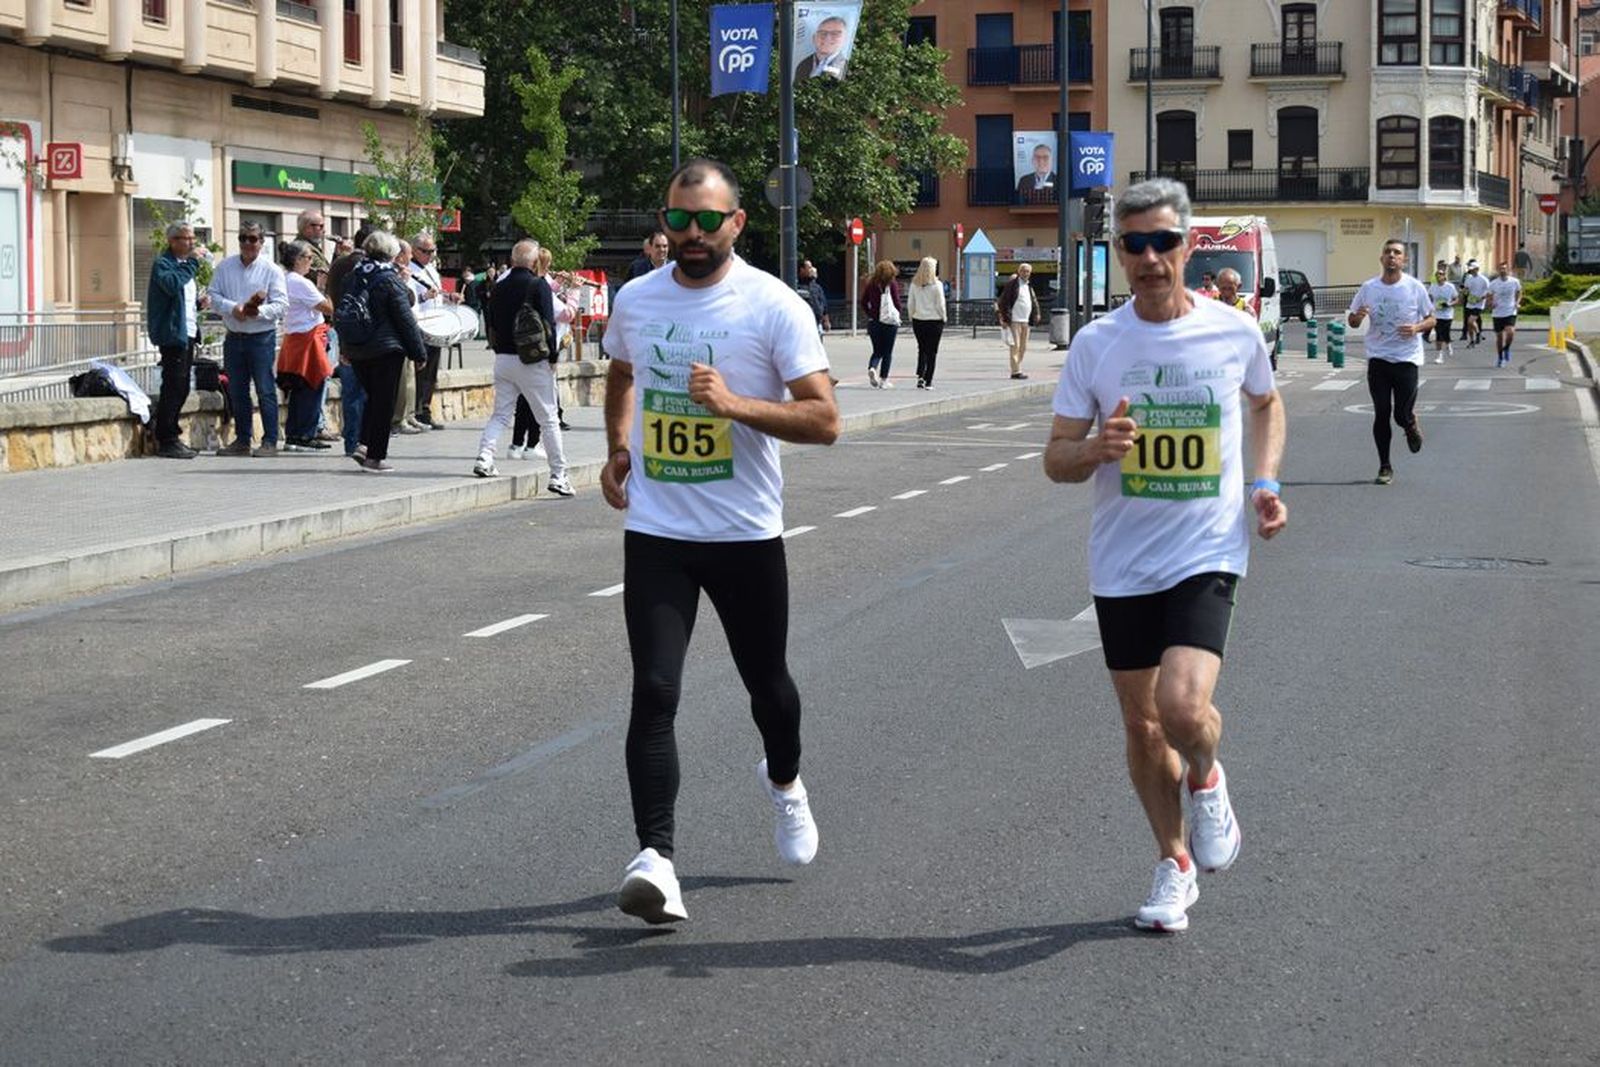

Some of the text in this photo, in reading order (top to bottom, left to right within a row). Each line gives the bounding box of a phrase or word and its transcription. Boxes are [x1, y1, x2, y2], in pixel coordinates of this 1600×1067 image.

[720, 27, 759, 41] VOTA
[1079, 146, 1105, 155] VOTA
[650, 418, 715, 457] 165
[1133, 433, 1204, 470] 100
[663, 464, 728, 477] CAJA RURAL
[1148, 481, 1215, 493] CAJA RURAL
